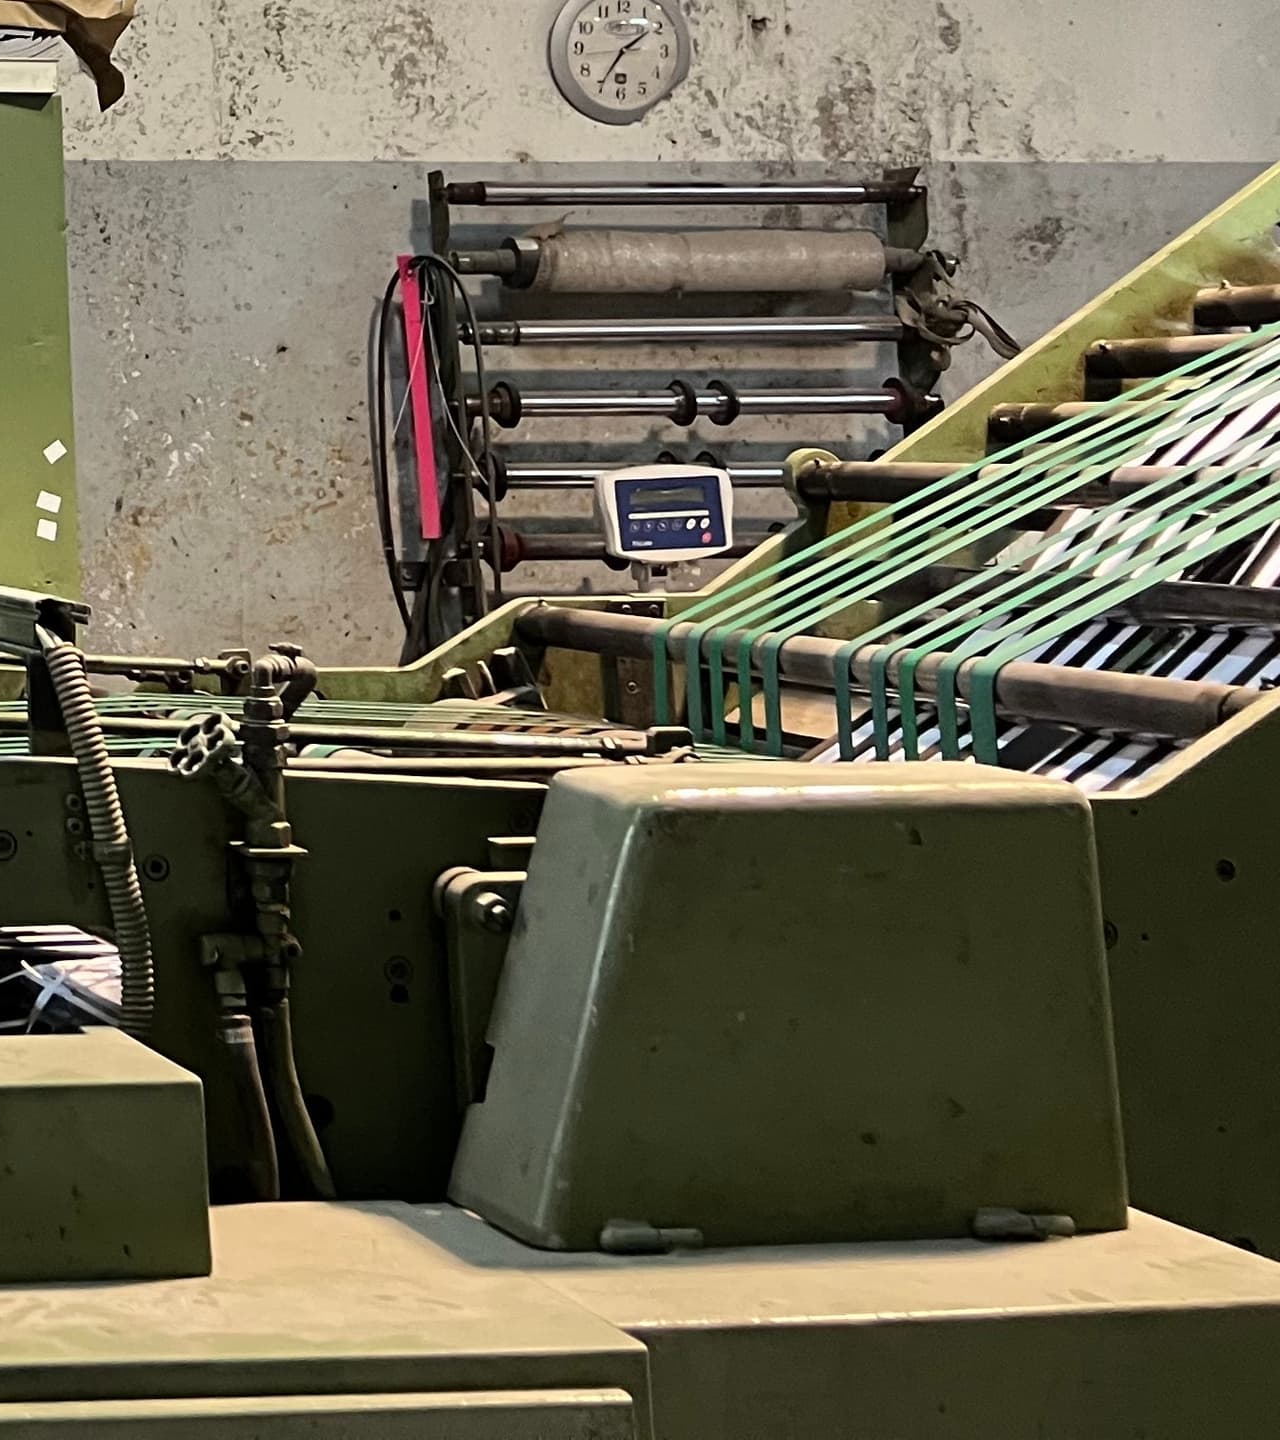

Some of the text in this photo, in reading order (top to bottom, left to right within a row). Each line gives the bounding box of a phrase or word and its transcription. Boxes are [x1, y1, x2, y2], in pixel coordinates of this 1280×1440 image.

[598, 5, 609, 18] 11
[617, 0, 631, 14] 12
[642, 7, 648, 19] 1
[578, 21, 594, 35] 10
[653, 21, 663, 35] 2
[574, 41, 584, 55] 9
[660, 45, 669, 59] 3
[580, 63, 591, 77] 8
[597, 80, 605, 94] 7
[616, 87, 626, 101] 6
[638, 82, 646, 95] 5
